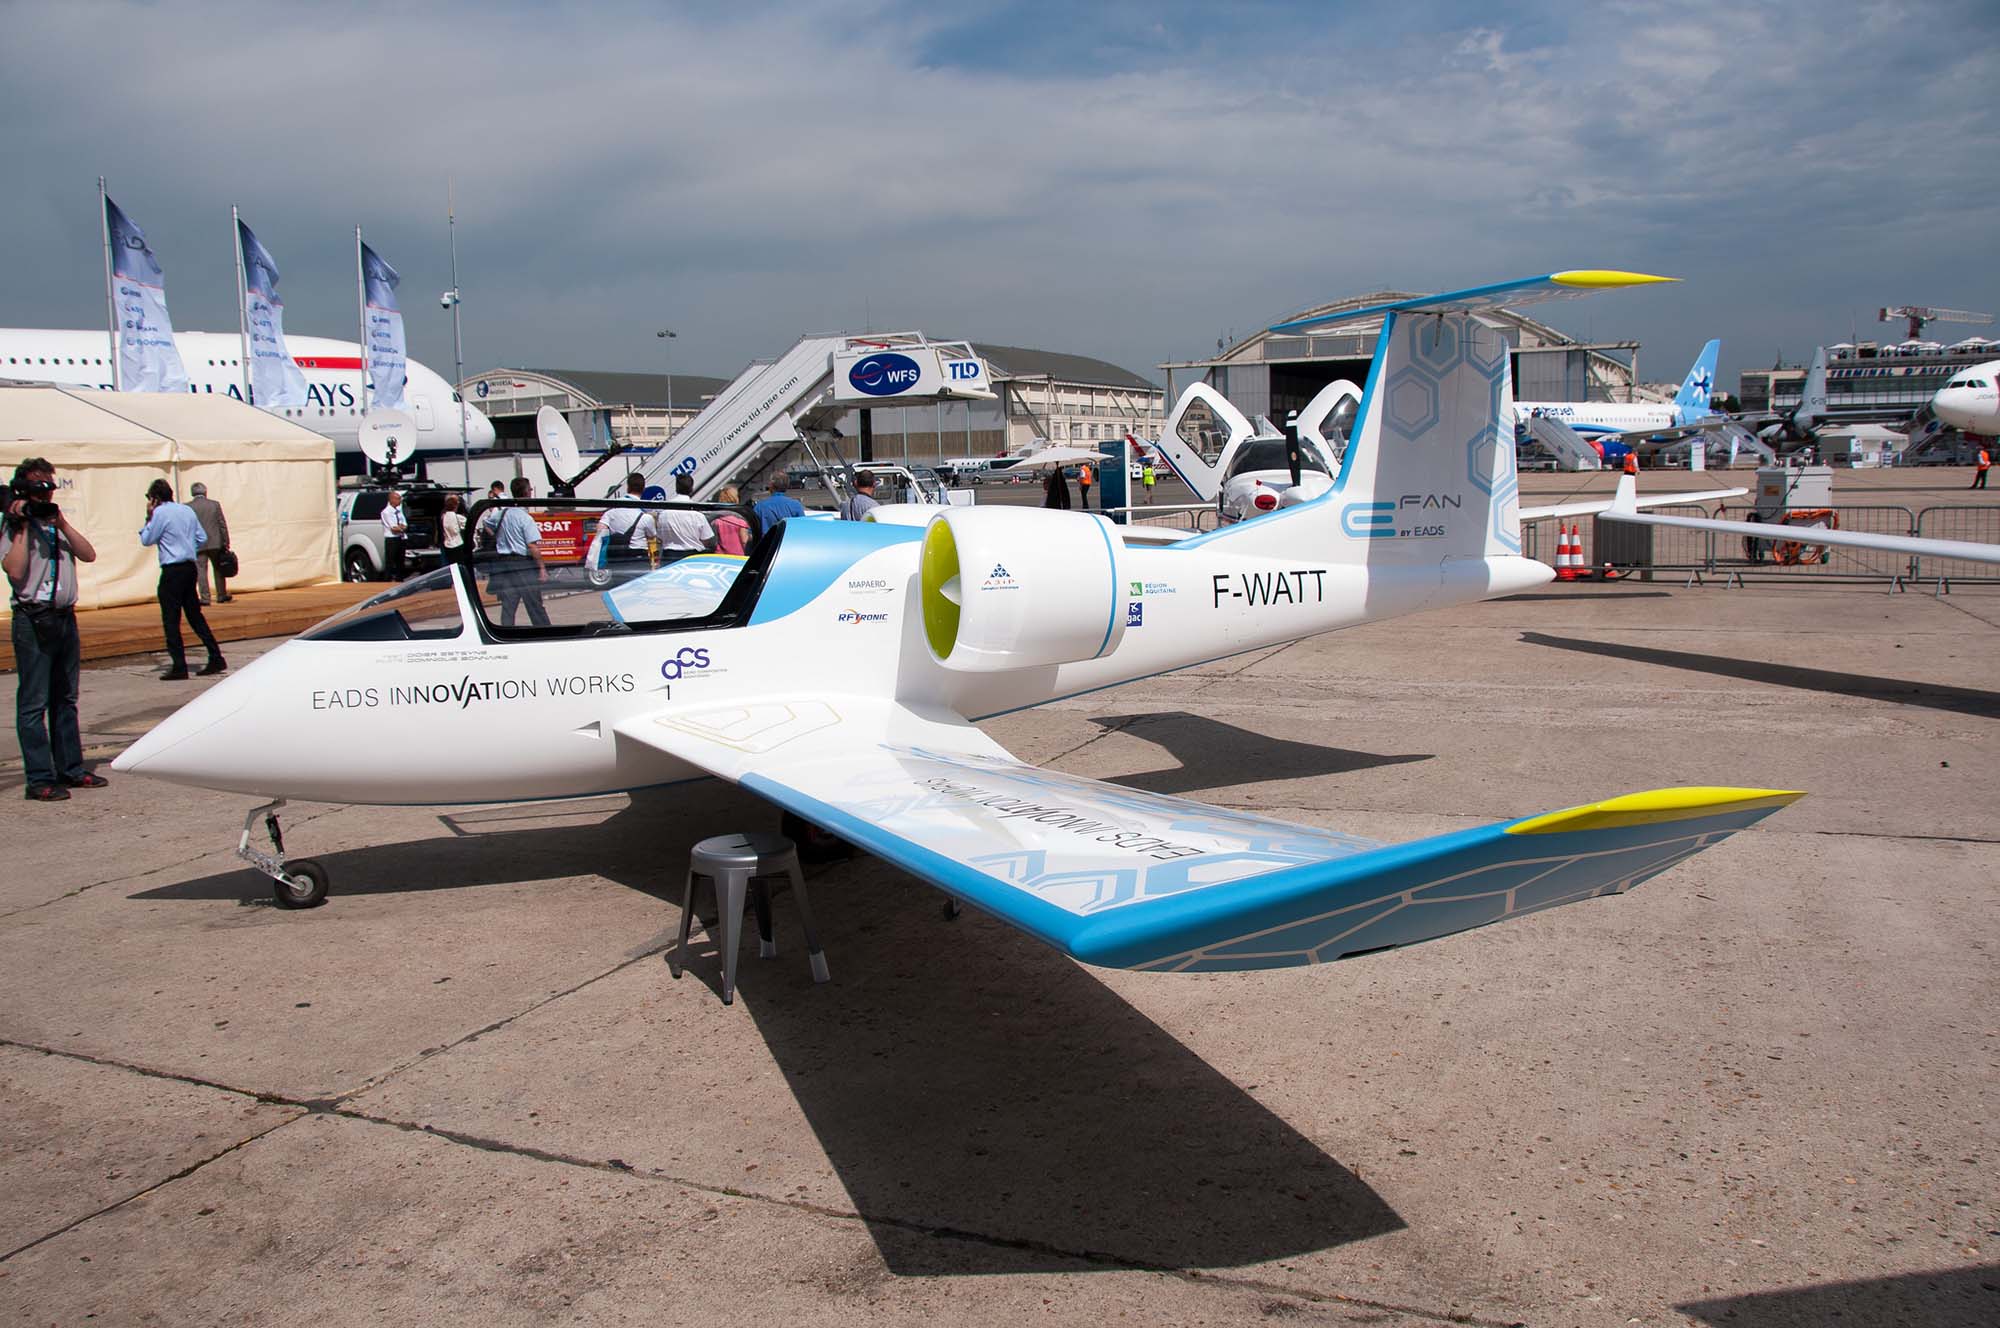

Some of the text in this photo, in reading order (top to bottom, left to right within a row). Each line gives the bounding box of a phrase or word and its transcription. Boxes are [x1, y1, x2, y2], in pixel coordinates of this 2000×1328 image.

[887, 368, 918, 384] WFS
[949, 362, 980, 380] TLD
[1831, 367, 1894, 378] TERMINAL
[669, 456, 697, 478] TLD
[1399, 494, 1462, 510] FAN
[535, 520, 572, 532] RSAT
[1414, 525, 1445, 536] EADS
[848, 580, 887, 589] MAPAERO
[1213, 569, 1327, 609] F-WATT
[312, 673, 635, 710] EADS INNOVATION WORKS
[1096, 831, 1206, 861] EADS
